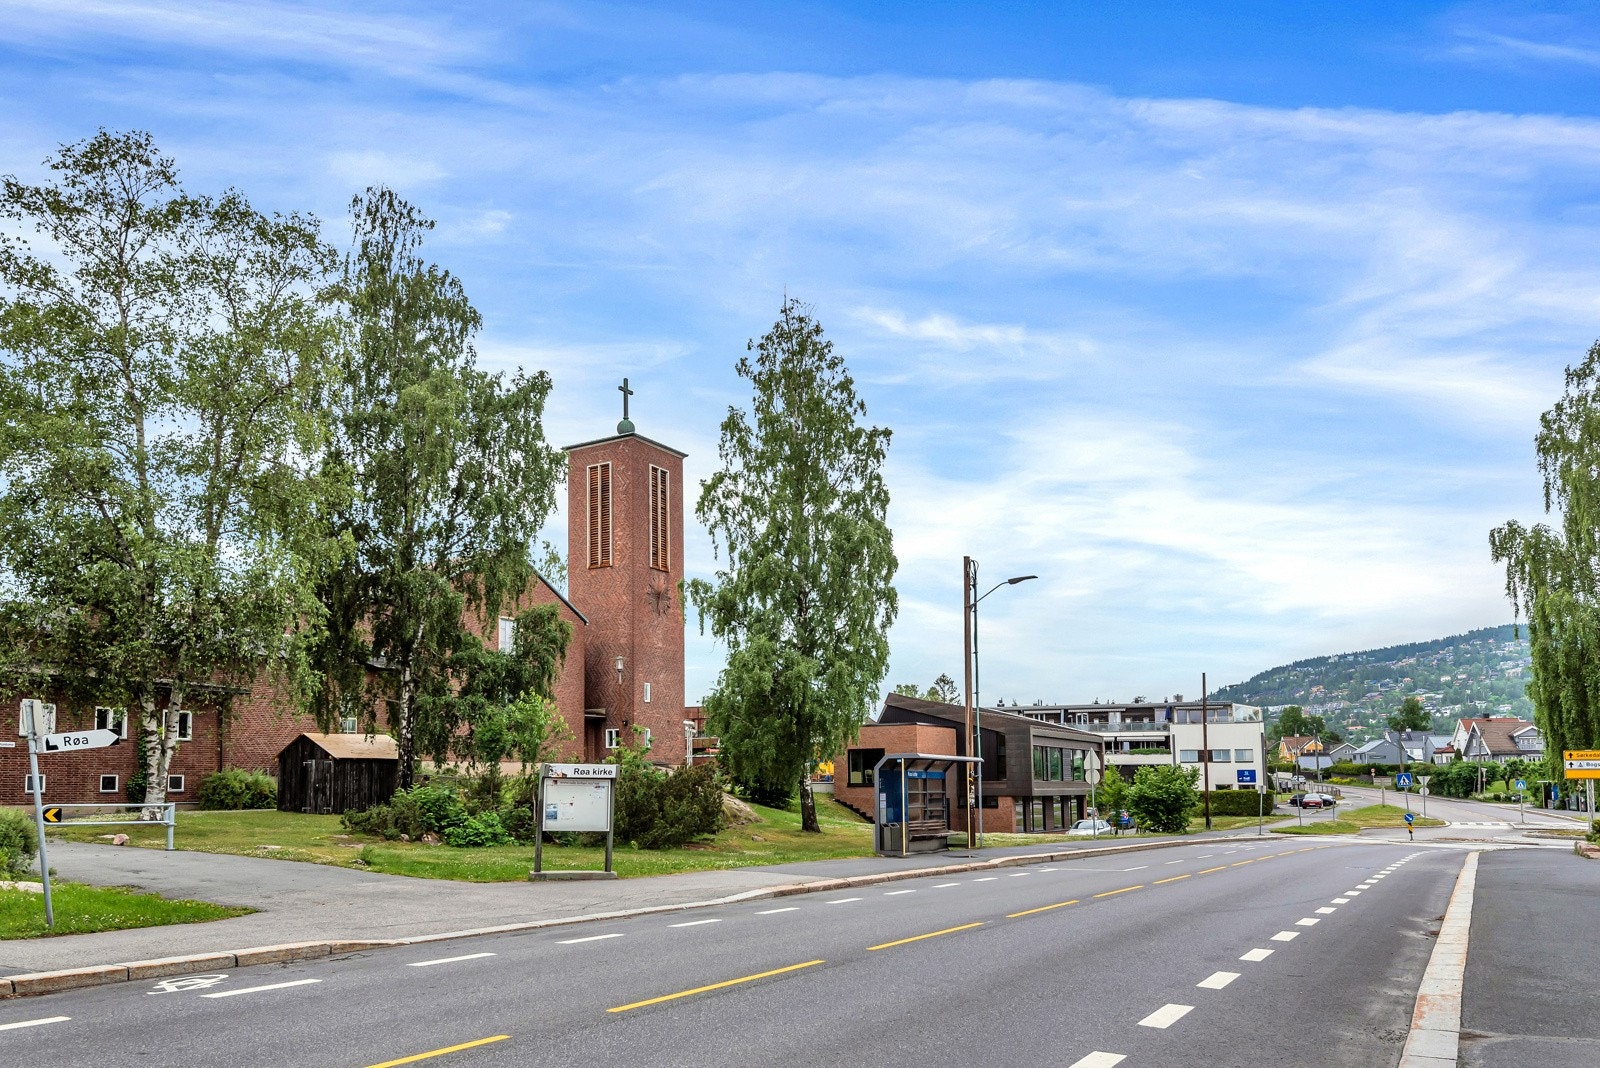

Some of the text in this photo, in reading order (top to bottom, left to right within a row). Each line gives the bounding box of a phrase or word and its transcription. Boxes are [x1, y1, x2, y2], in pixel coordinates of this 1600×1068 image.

[64, 736, 89, 746] Røa
[573, 767, 613, 776] Røa kirke
